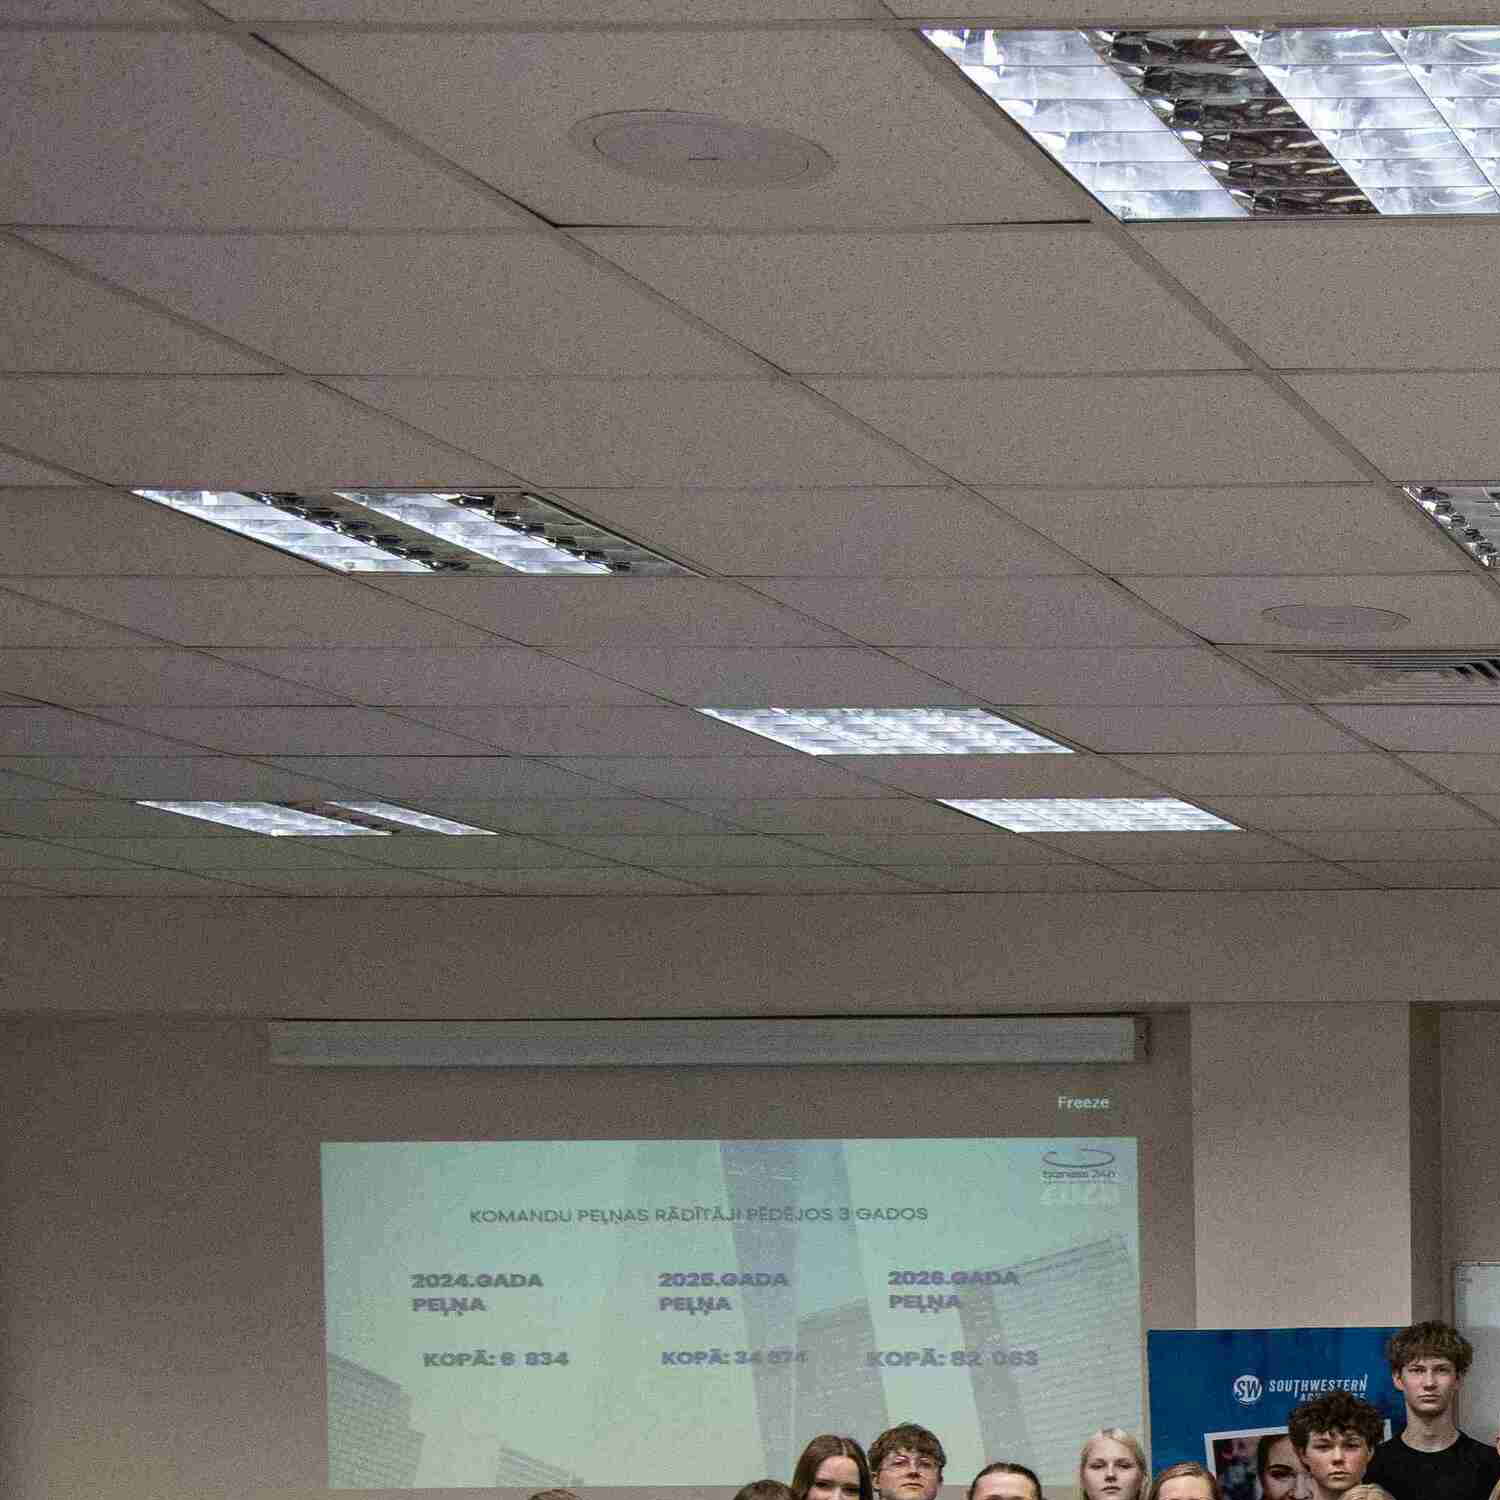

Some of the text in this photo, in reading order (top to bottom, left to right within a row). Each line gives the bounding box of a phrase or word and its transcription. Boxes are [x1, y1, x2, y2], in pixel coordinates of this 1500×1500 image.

[1058, 1096, 1110, 1109] Freeze
[469, 1207, 572, 1224] KOMANDU
[855, 1205, 928, 1221] GADOS
[1269, 1376, 1368, 1396] SOUTHWESTERN
